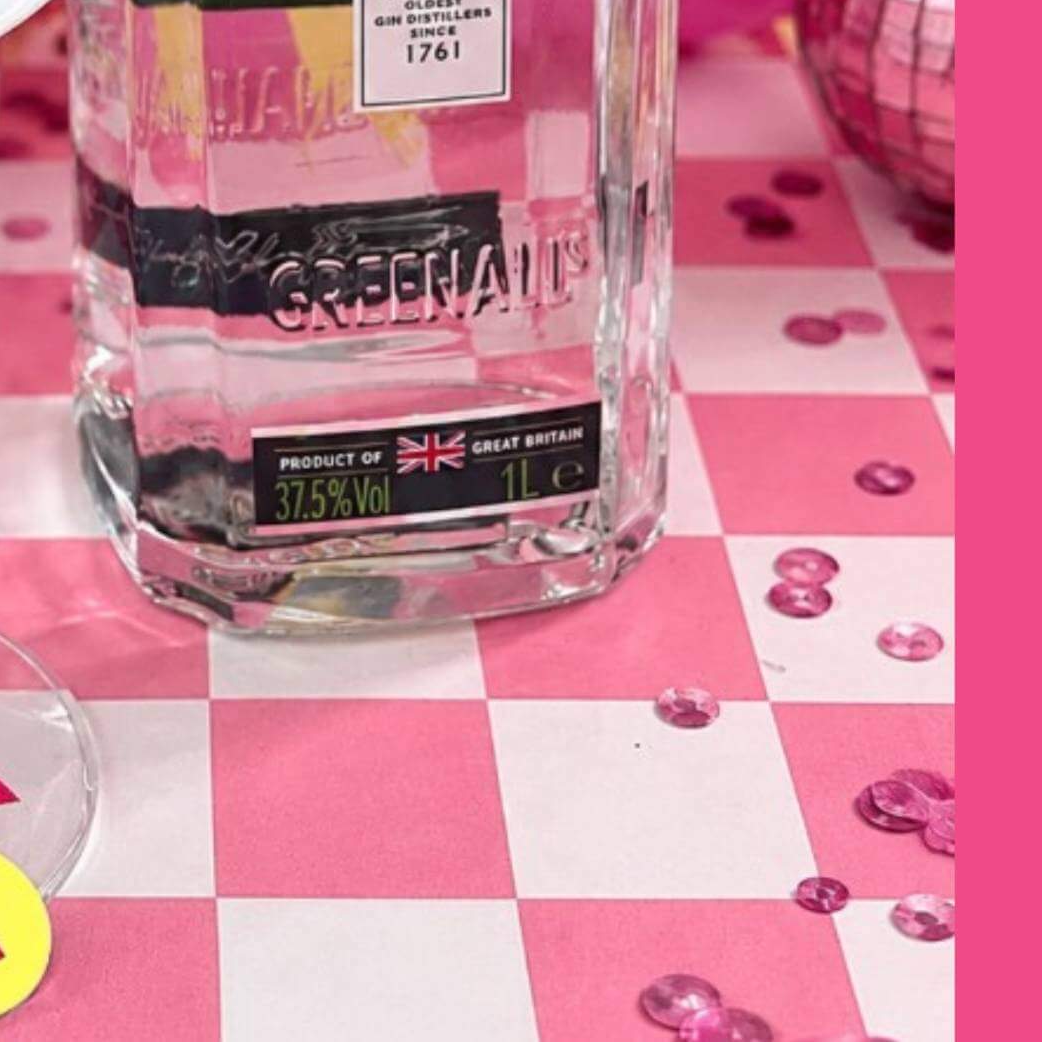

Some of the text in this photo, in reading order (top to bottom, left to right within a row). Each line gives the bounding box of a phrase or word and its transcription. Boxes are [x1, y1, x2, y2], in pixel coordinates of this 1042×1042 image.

[374, 8, 492, 26] GIN DISTILLERS
[410, 26, 457, 38] SINCE
[407, 41, 460, 63] 1761
[472, 427, 584, 454] GREAT BRITAIN
[279, 451, 383, 471] PRODUCT OF
[500, 458, 539, 501] 1L
